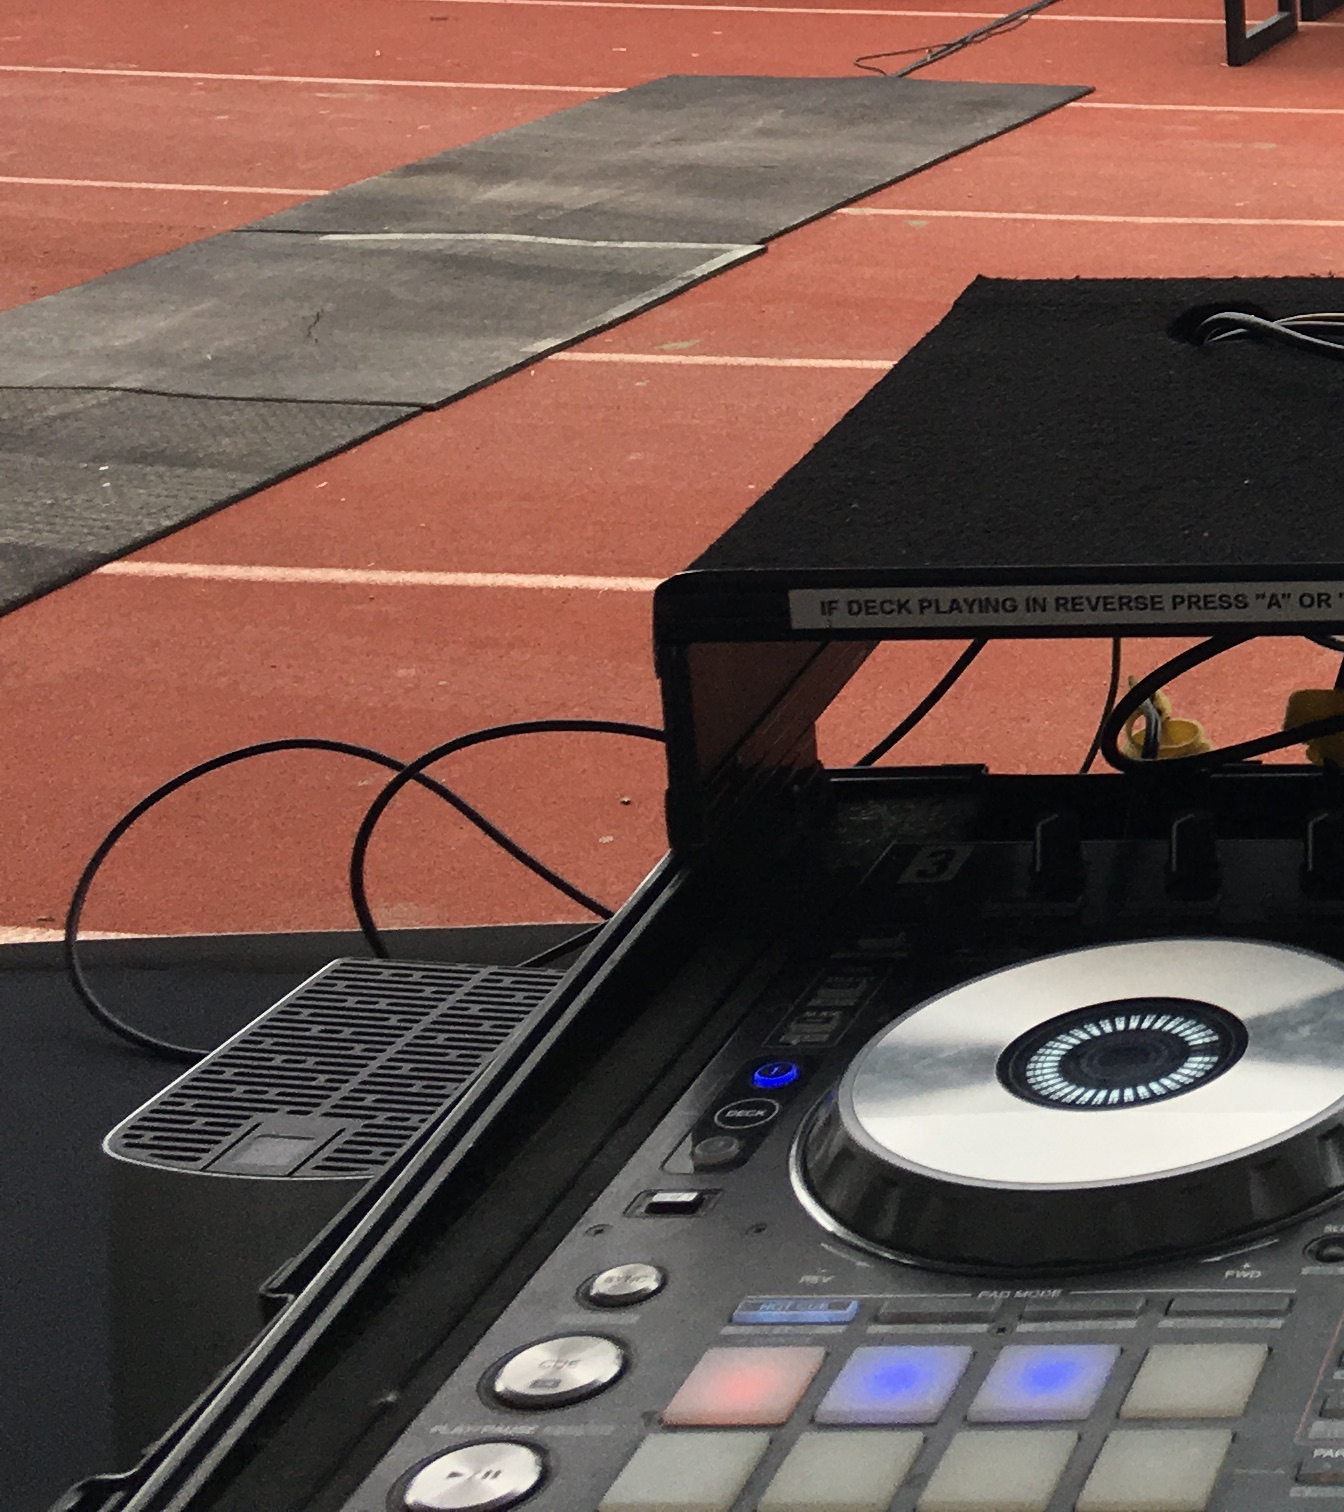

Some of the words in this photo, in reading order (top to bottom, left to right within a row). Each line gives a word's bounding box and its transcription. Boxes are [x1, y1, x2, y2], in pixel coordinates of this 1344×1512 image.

[821, 600, 839, 616] IF
[847, 598, 913, 617] DECK
[918, 597, 1018, 615] PLAYING
[1026, 597, 1047, 613] IN
[1055, 595, 1165, 613] REVERSE
[1172, 592, 1249, 611] PRESS
[1255, 592, 1292, 610] "A"
[1299, 592, 1332, 609] OR
